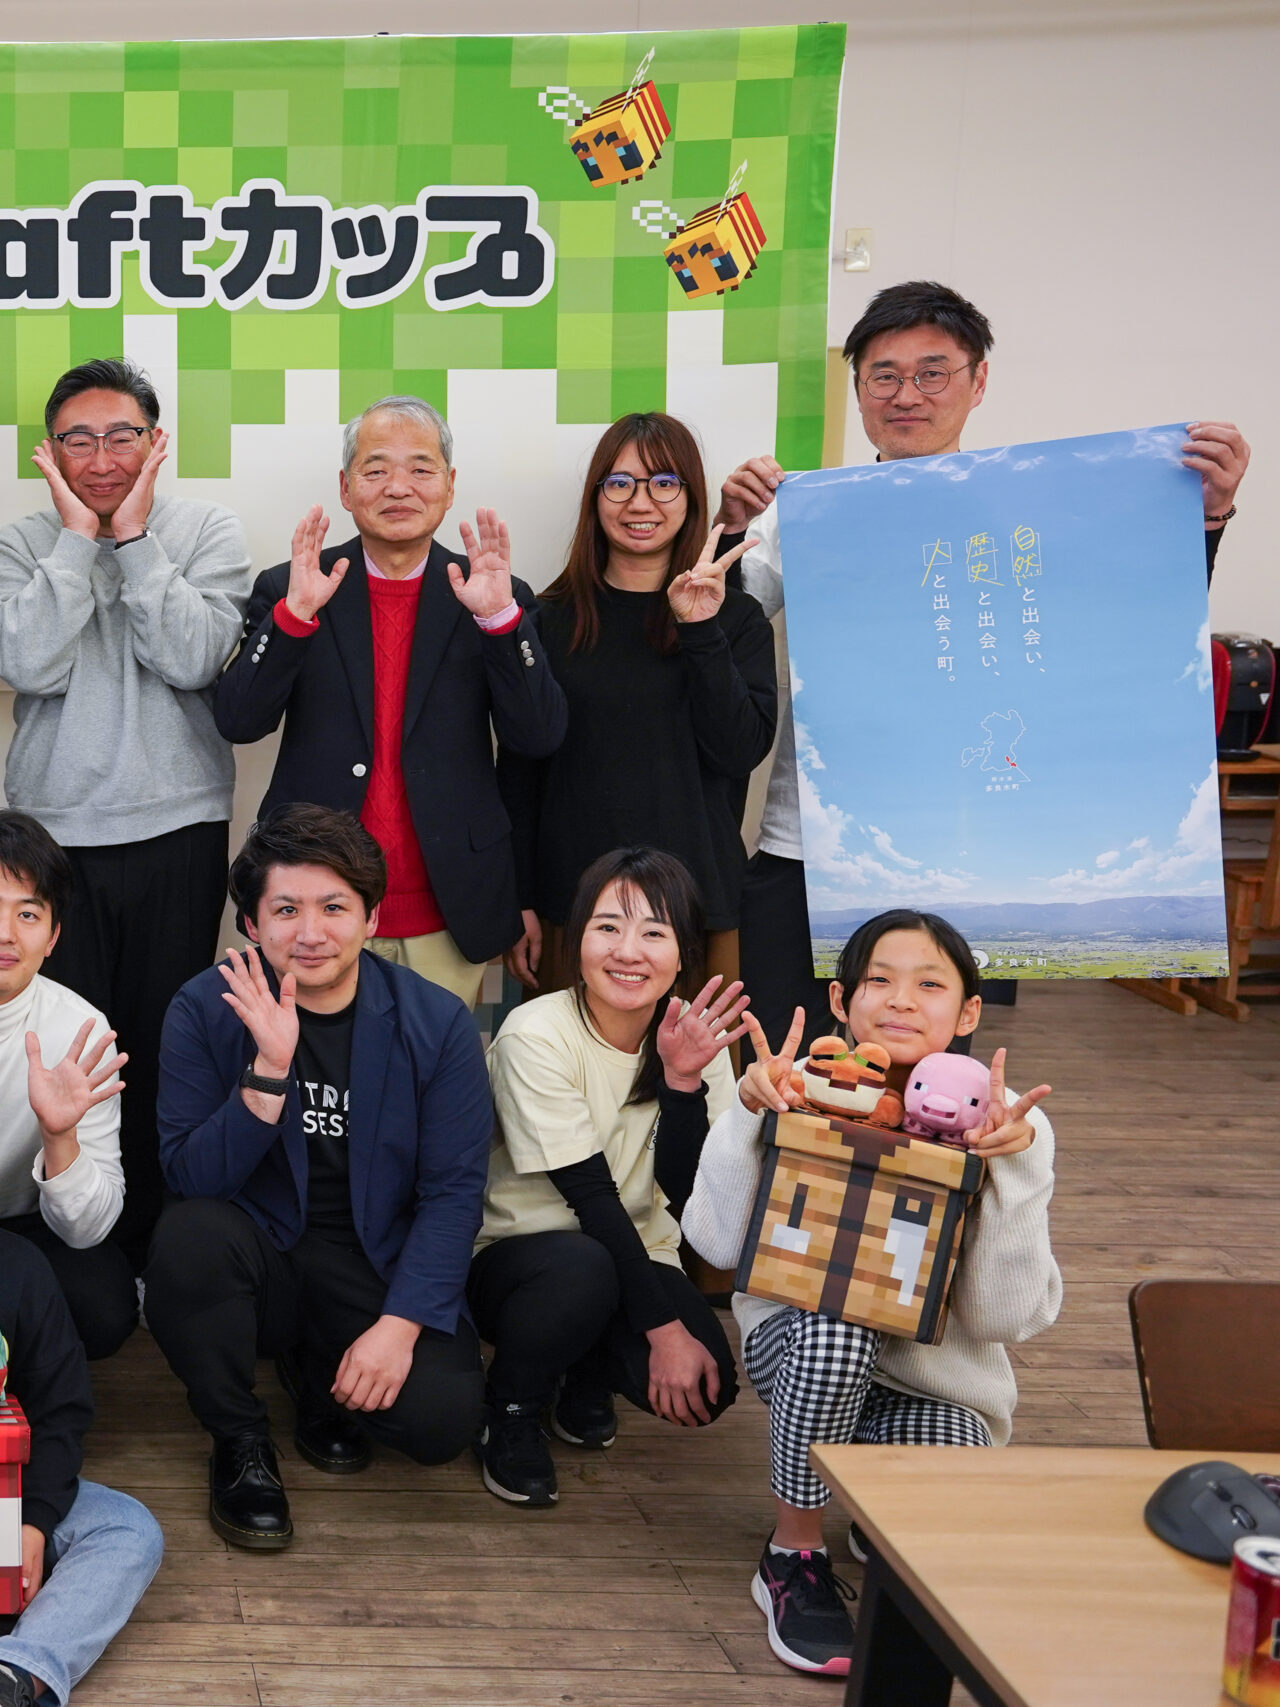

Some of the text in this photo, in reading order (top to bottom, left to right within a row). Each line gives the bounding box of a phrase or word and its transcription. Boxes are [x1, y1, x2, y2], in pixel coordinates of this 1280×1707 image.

[995, 957, 1048, 968] 多良木町
[302, 1110, 349, 1137] SES
